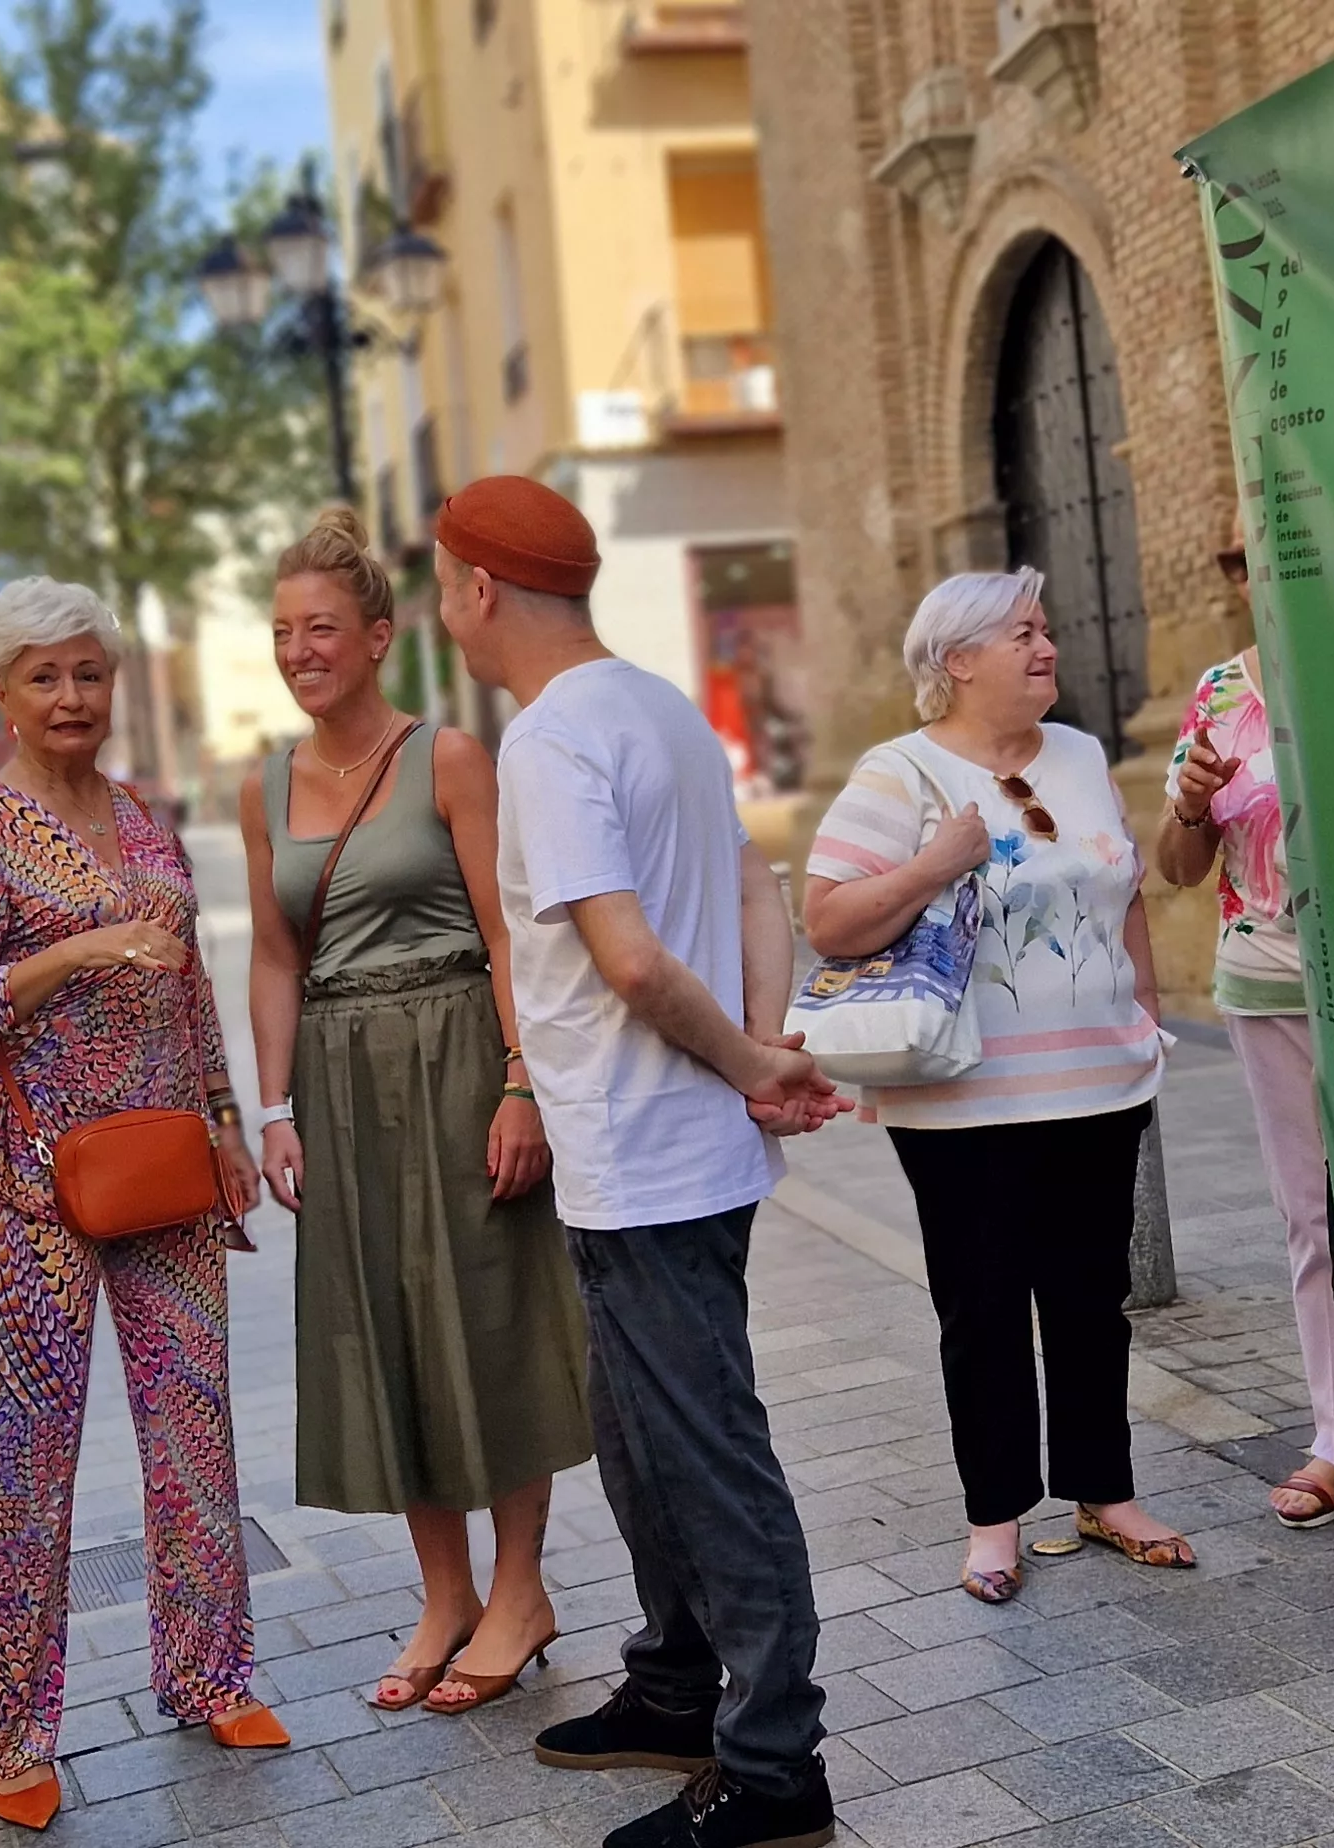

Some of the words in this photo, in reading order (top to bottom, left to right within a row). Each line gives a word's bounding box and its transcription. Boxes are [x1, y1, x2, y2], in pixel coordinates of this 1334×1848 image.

[1280, 251, 1304, 278] del
[1277, 288, 1288, 309] 9
[1272, 317, 1291, 339] al
[1270, 349, 1287, 370] 15
[1269, 380, 1288, 401] de
[1270, 407, 1326, 436] agosto
[1274, 468, 1306, 485] Fiestas
[1275, 485, 1324, 504] declaradas
[1275, 510, 1289, 524] de
[1276, 527, 1313, 543] interés
[1278, 563, 1324, 582] nacional
